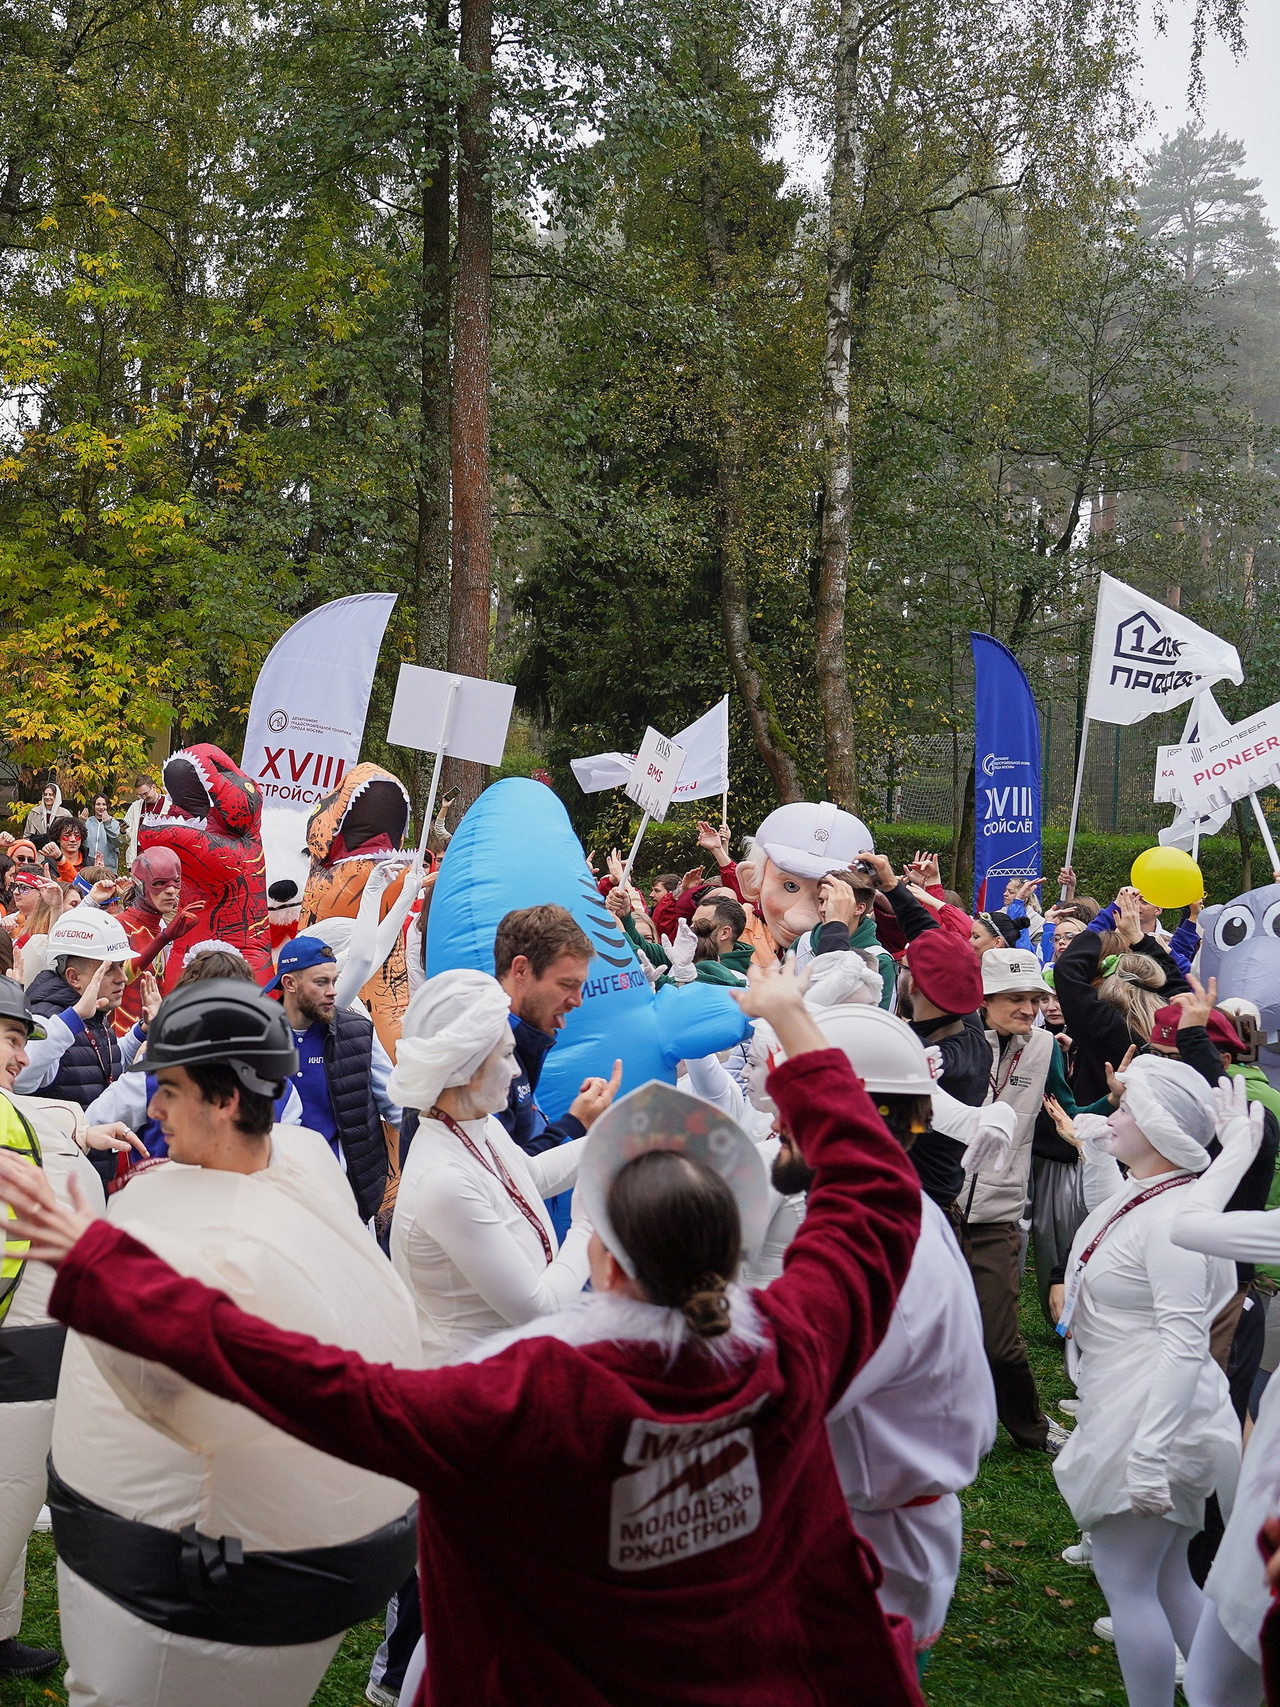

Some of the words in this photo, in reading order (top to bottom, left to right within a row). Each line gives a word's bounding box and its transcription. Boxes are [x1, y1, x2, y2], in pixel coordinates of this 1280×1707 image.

[656, 737, 673, 759] BMS
[1209, 721, 1268, 753] PIONEER
[258, 746, 345, 789] XVIII
[647, 763, 664, 783] BMS
[1193, 736, 1280, 786] PIONEER
[1141, 1184, 1164, 1200] ГОРОДА
[621, 1482, 754, 1541] МОЛОДЁЖЬ
[620, 1505, 747, 1562] РЖДСТРОЙ
